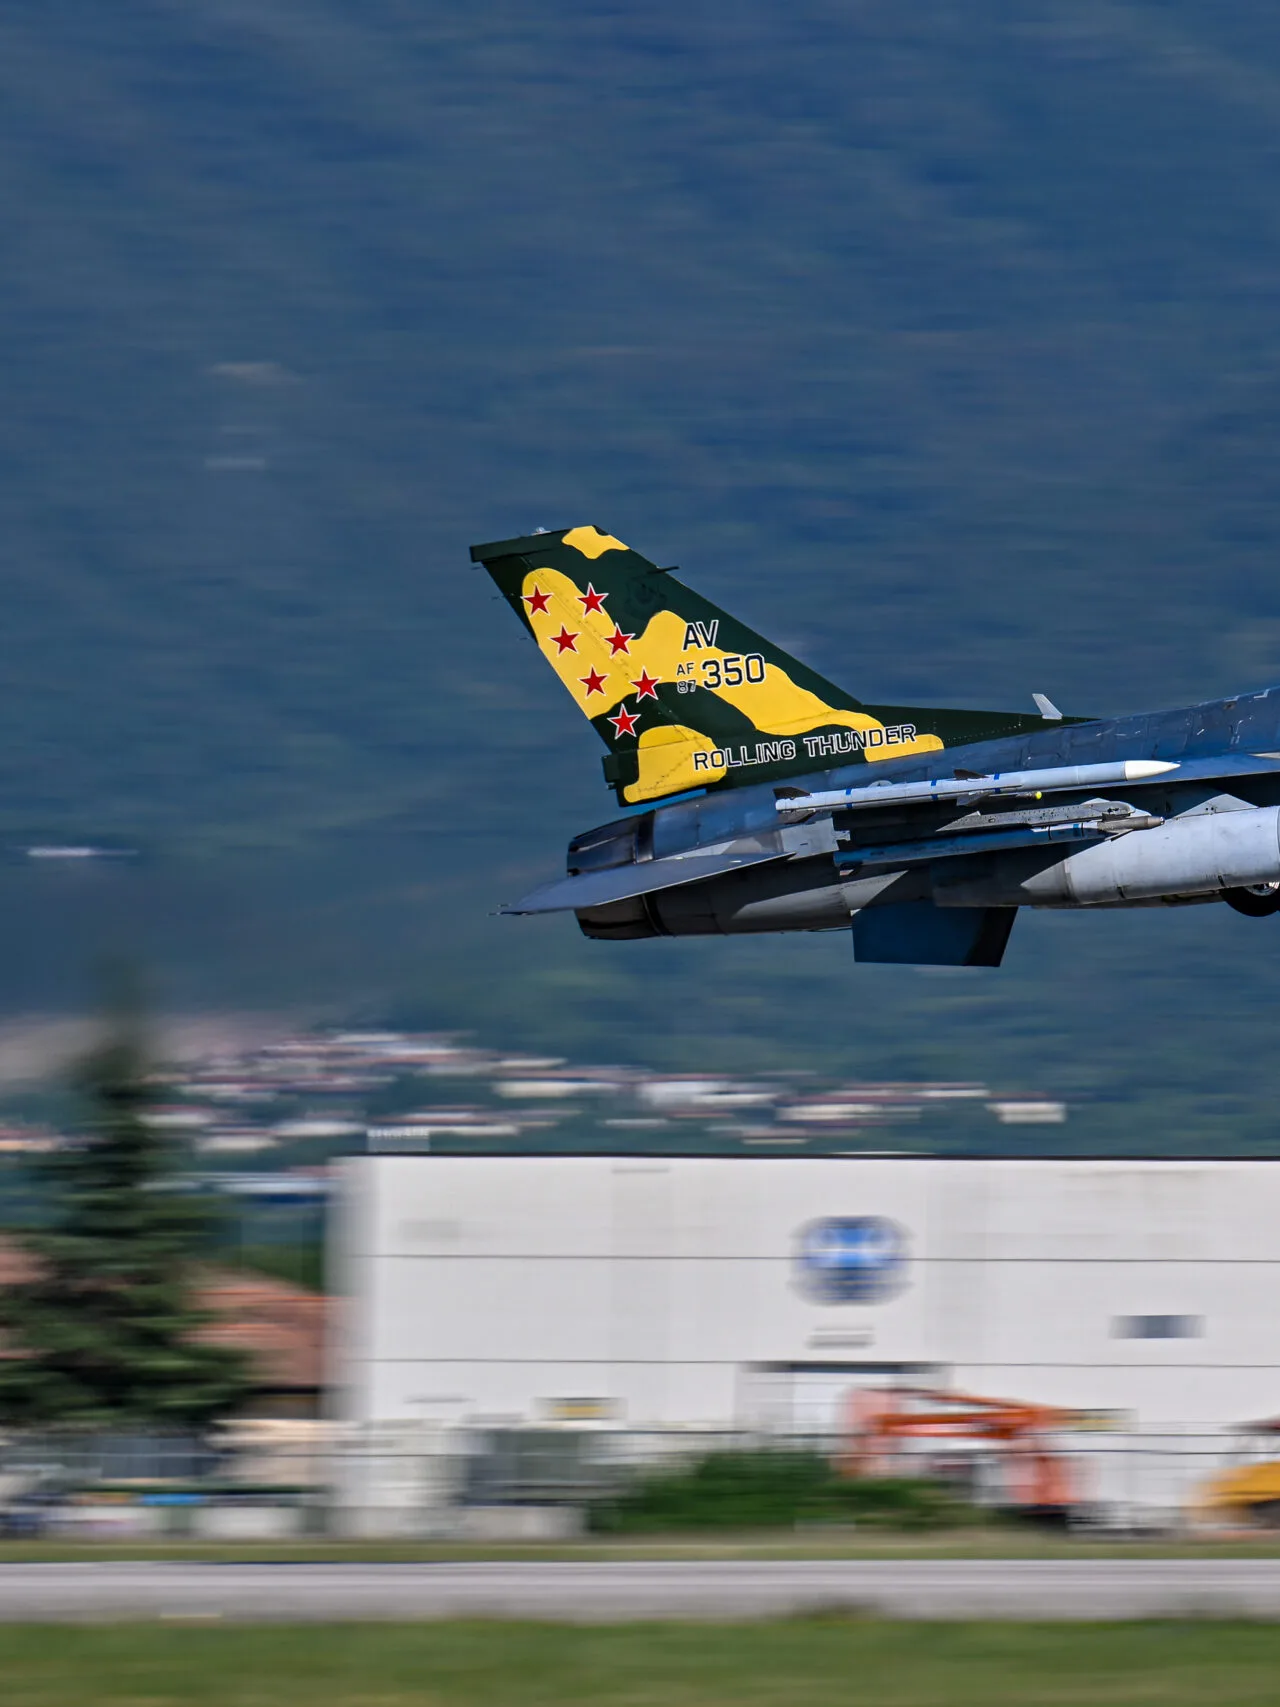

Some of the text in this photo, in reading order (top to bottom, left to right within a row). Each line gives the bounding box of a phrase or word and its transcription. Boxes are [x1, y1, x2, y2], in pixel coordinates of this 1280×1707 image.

[682, 619, 719, 652] AV
[677, 653, 766, 690] AF 350
[677, 679, 696, 694] 87
[693, 723, 917, 770] ROLLING THUNDER
